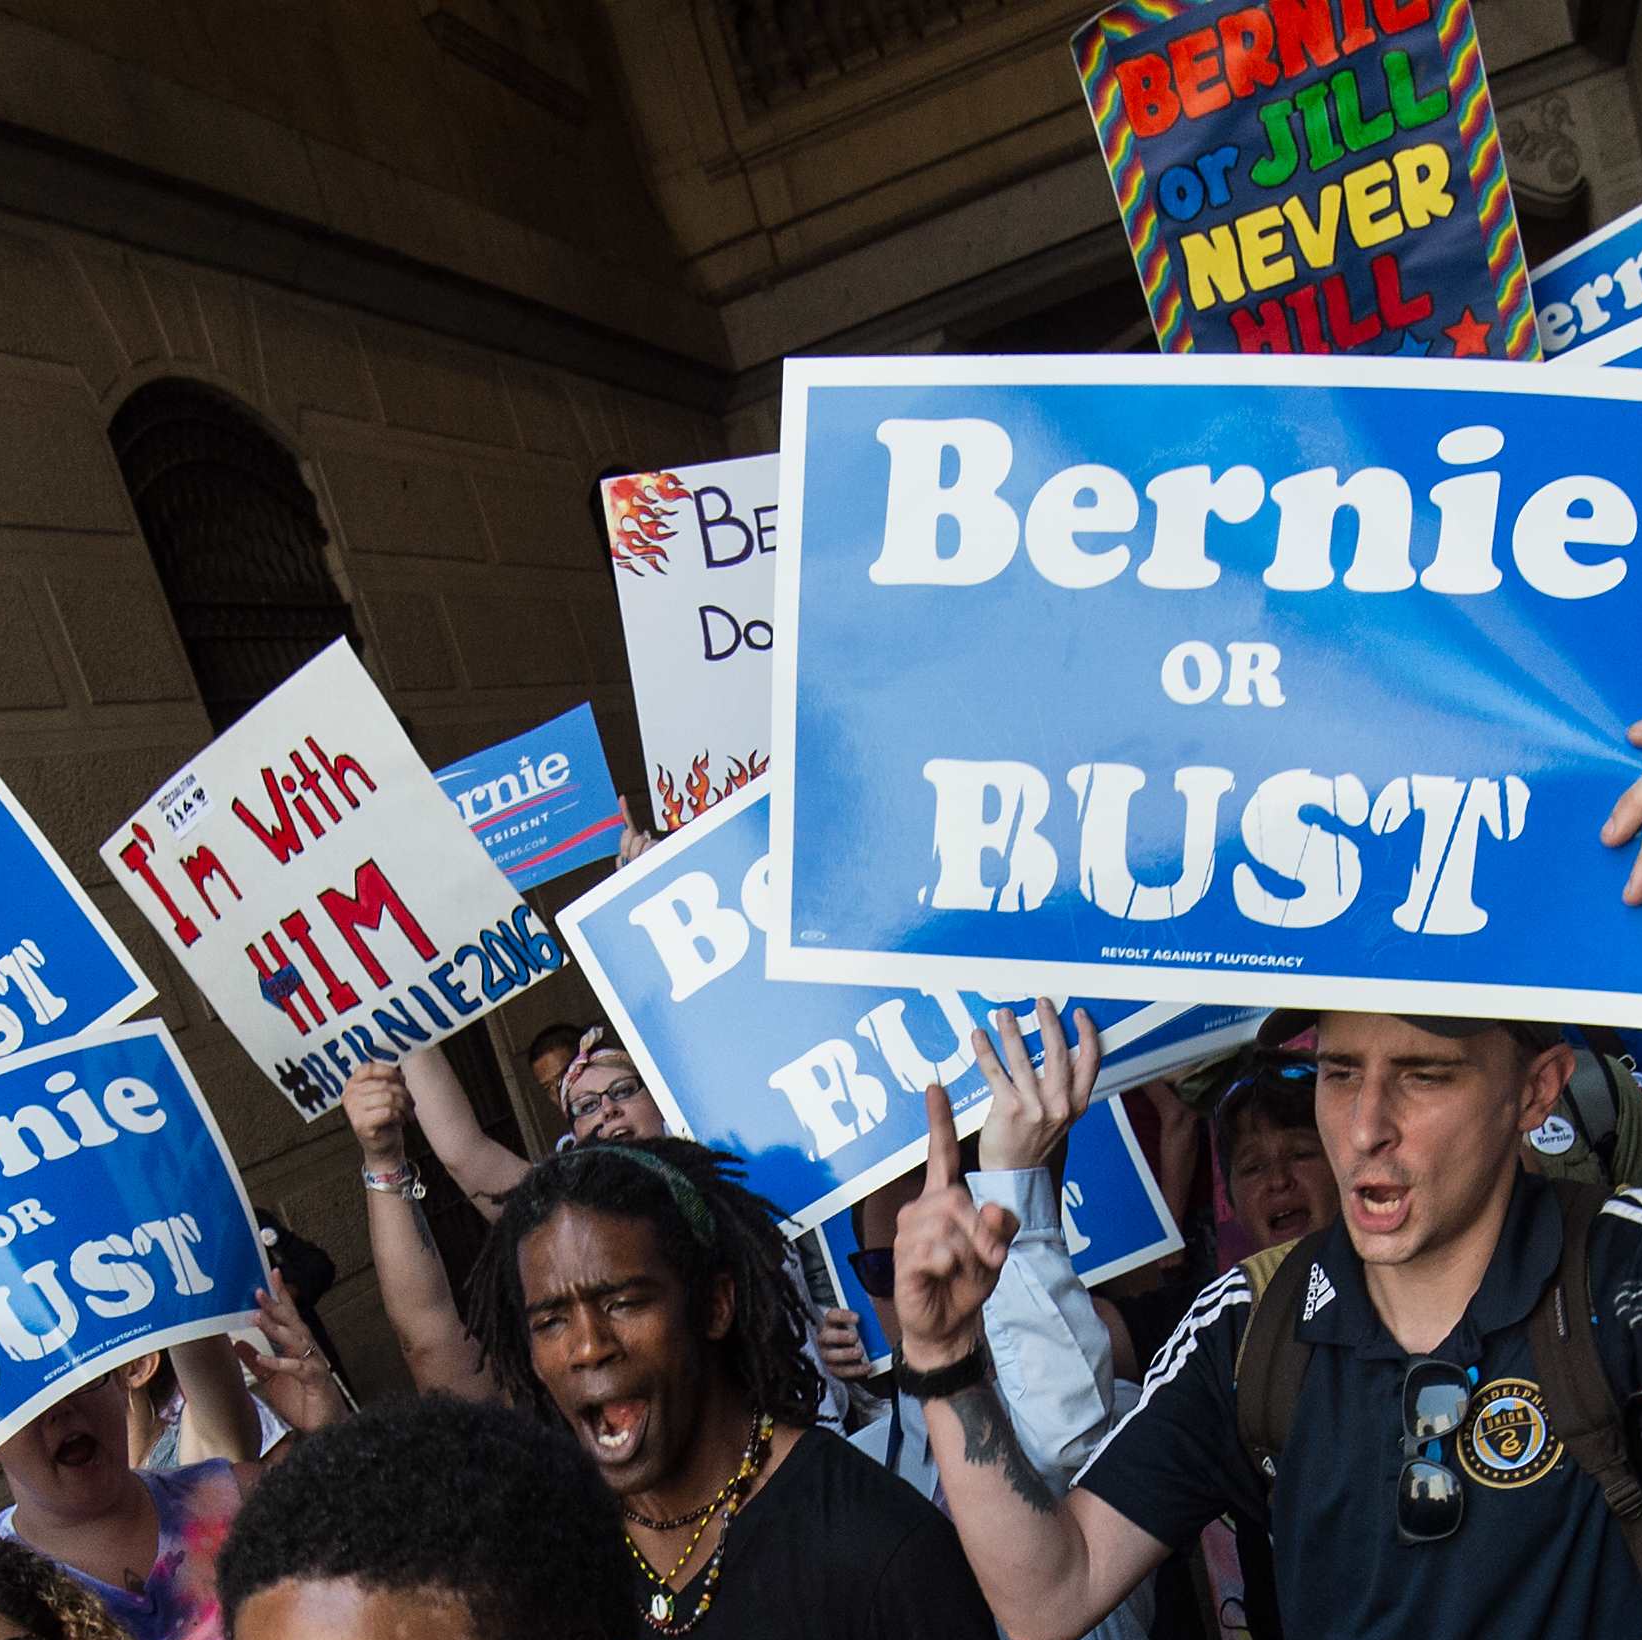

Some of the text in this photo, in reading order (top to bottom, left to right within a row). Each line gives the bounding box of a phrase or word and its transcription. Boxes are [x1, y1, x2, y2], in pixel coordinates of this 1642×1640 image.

[1158, 49, 1450, 222] or JILL
[1180, 143, 1456, 311] NEVER
[1229, 254, 1434, 355] HILL
[869, 417, 1639, 600] Bernie
[1161, 640, 1287, 708] OR
[120, 735, 378, 949] I'm With
[455, 751, 572, 826] rnie
[479, 811, 550, 849] ESIDENT
[920, 758, 1531, 936] BUST
[245, 858, 440, 1036] HIM
[274, 904, 565, 1114] #BERNIE2016
[1101, 946, 1305, 970] REVOLT AGAINST PLUTOCRACY
[1302, 1262, 1320, 1322] adidas
[1485, 1409, 1526, 1430] UNION
